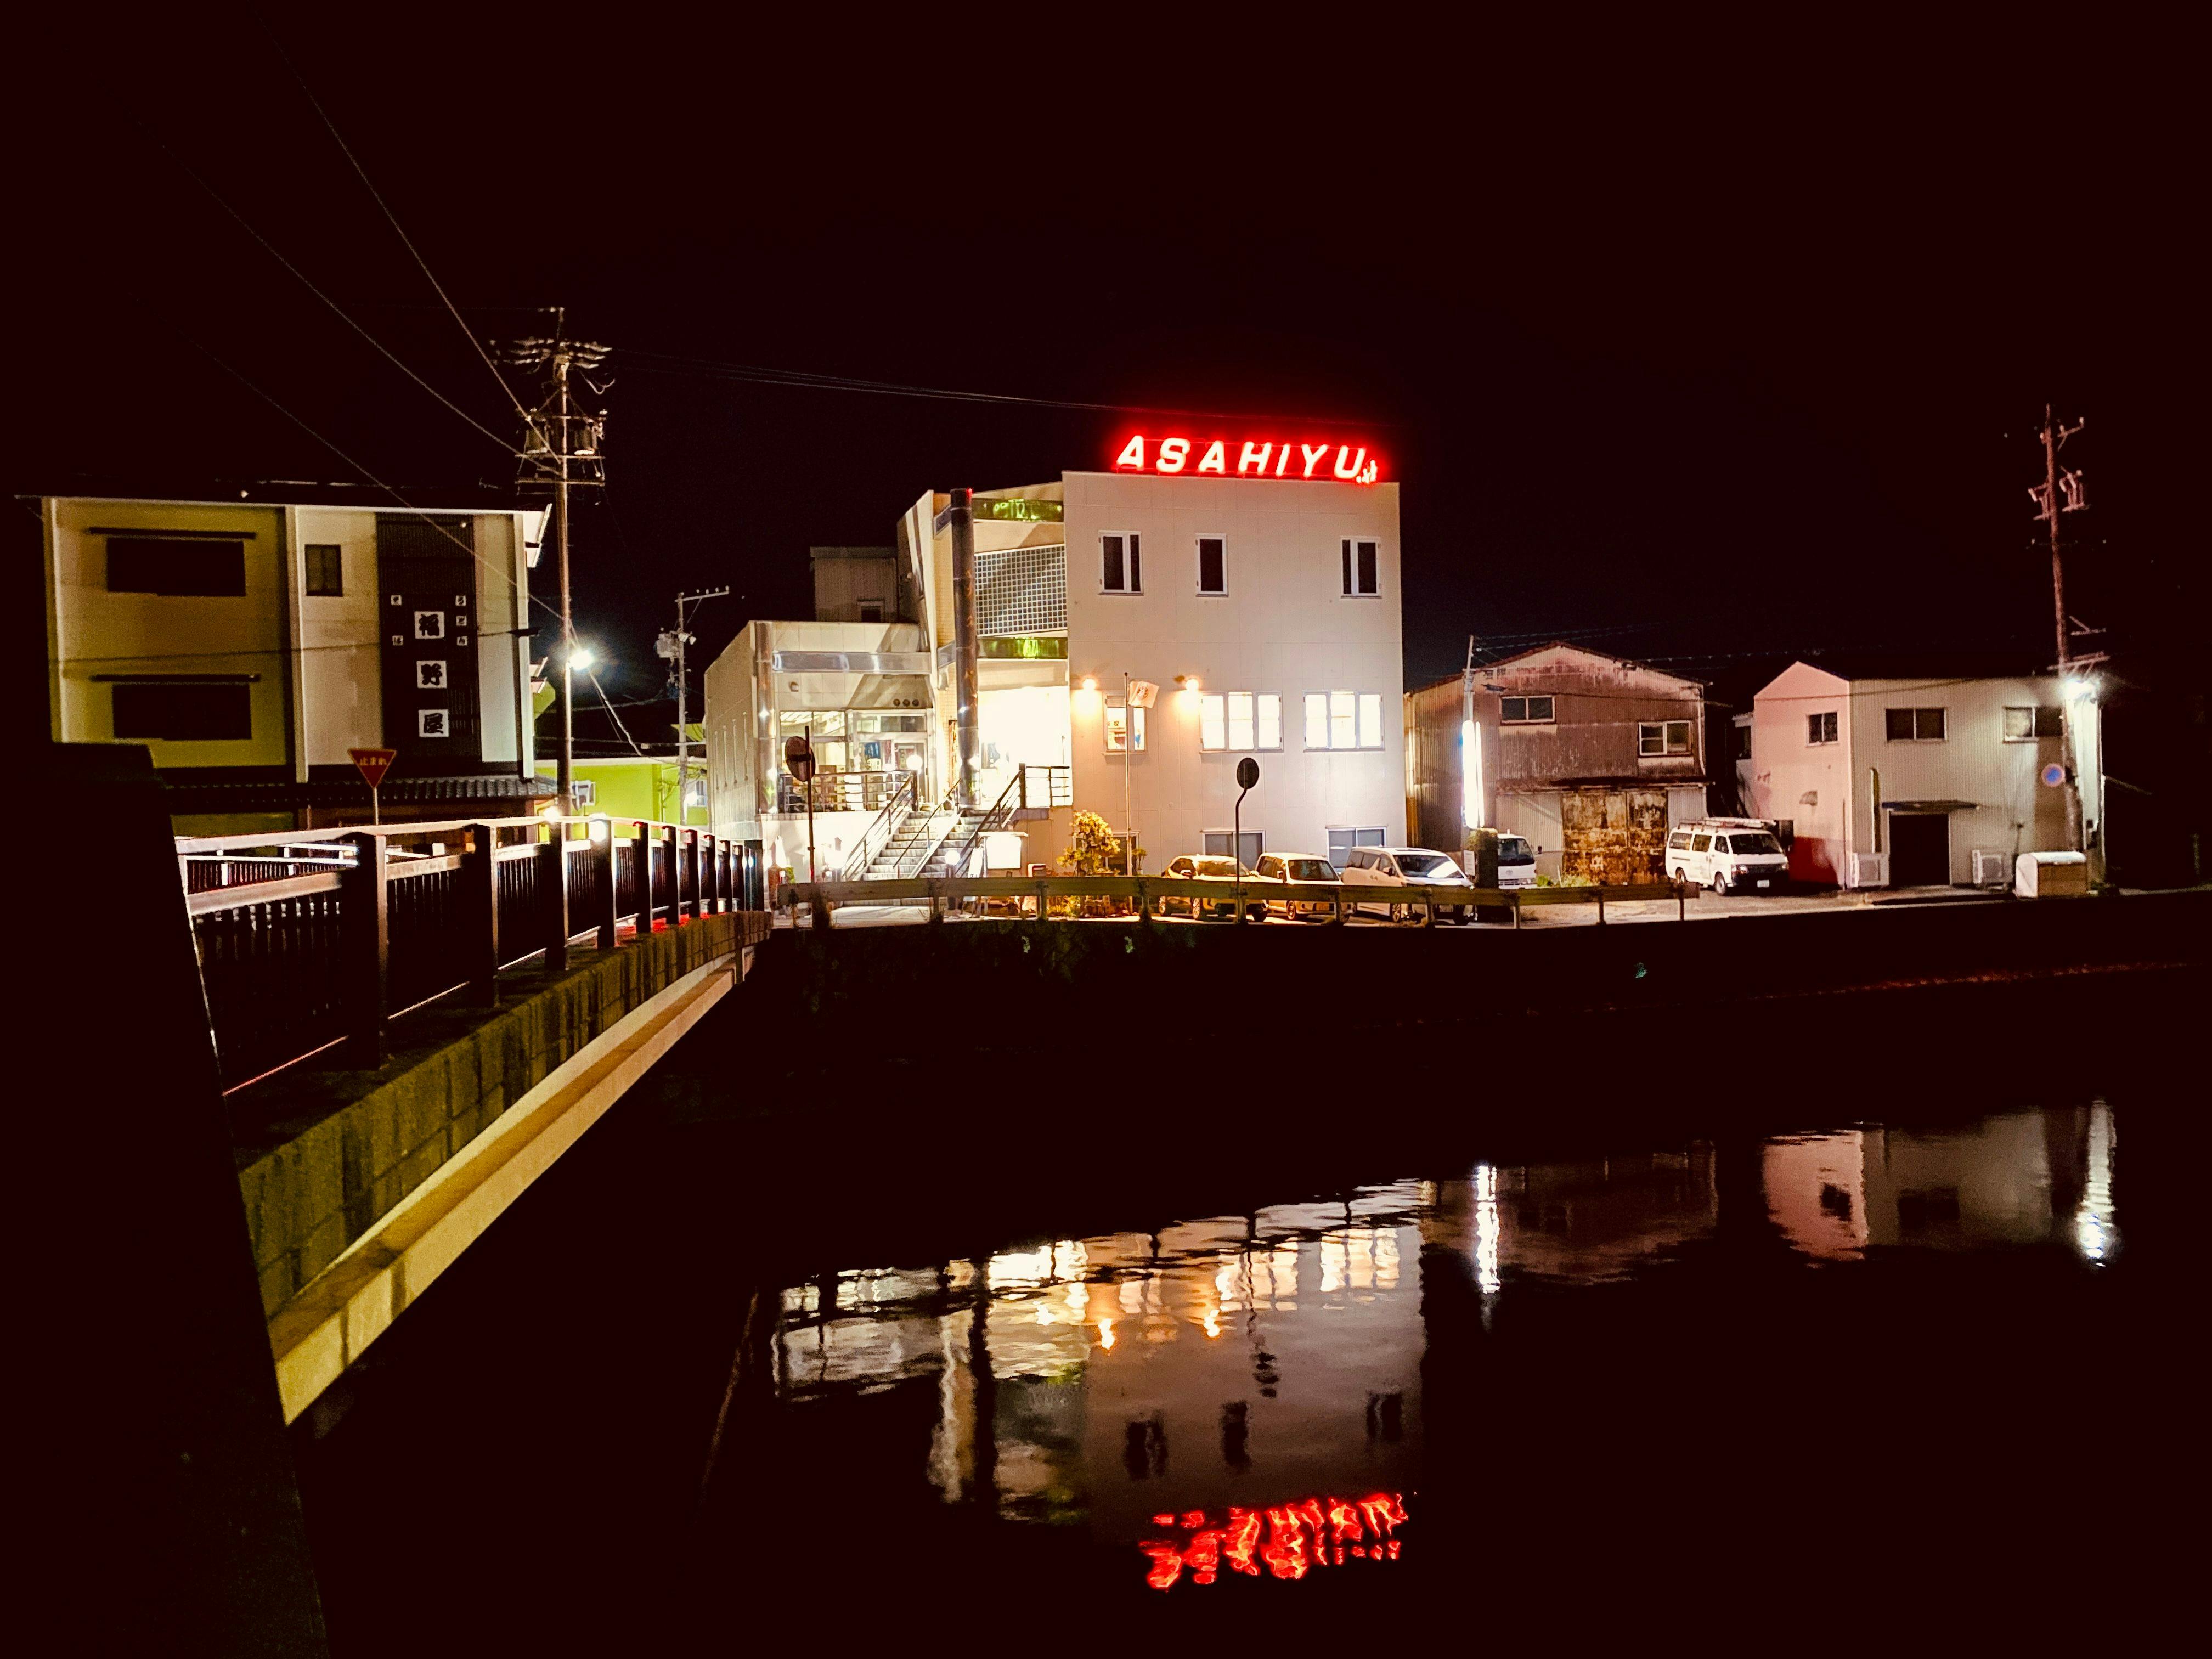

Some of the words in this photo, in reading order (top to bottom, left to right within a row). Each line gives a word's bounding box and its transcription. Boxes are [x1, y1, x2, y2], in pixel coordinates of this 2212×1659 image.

[1115, 435, 1366, 479] ASAHIYU
[359, 757, 387, 766] 止まれ
